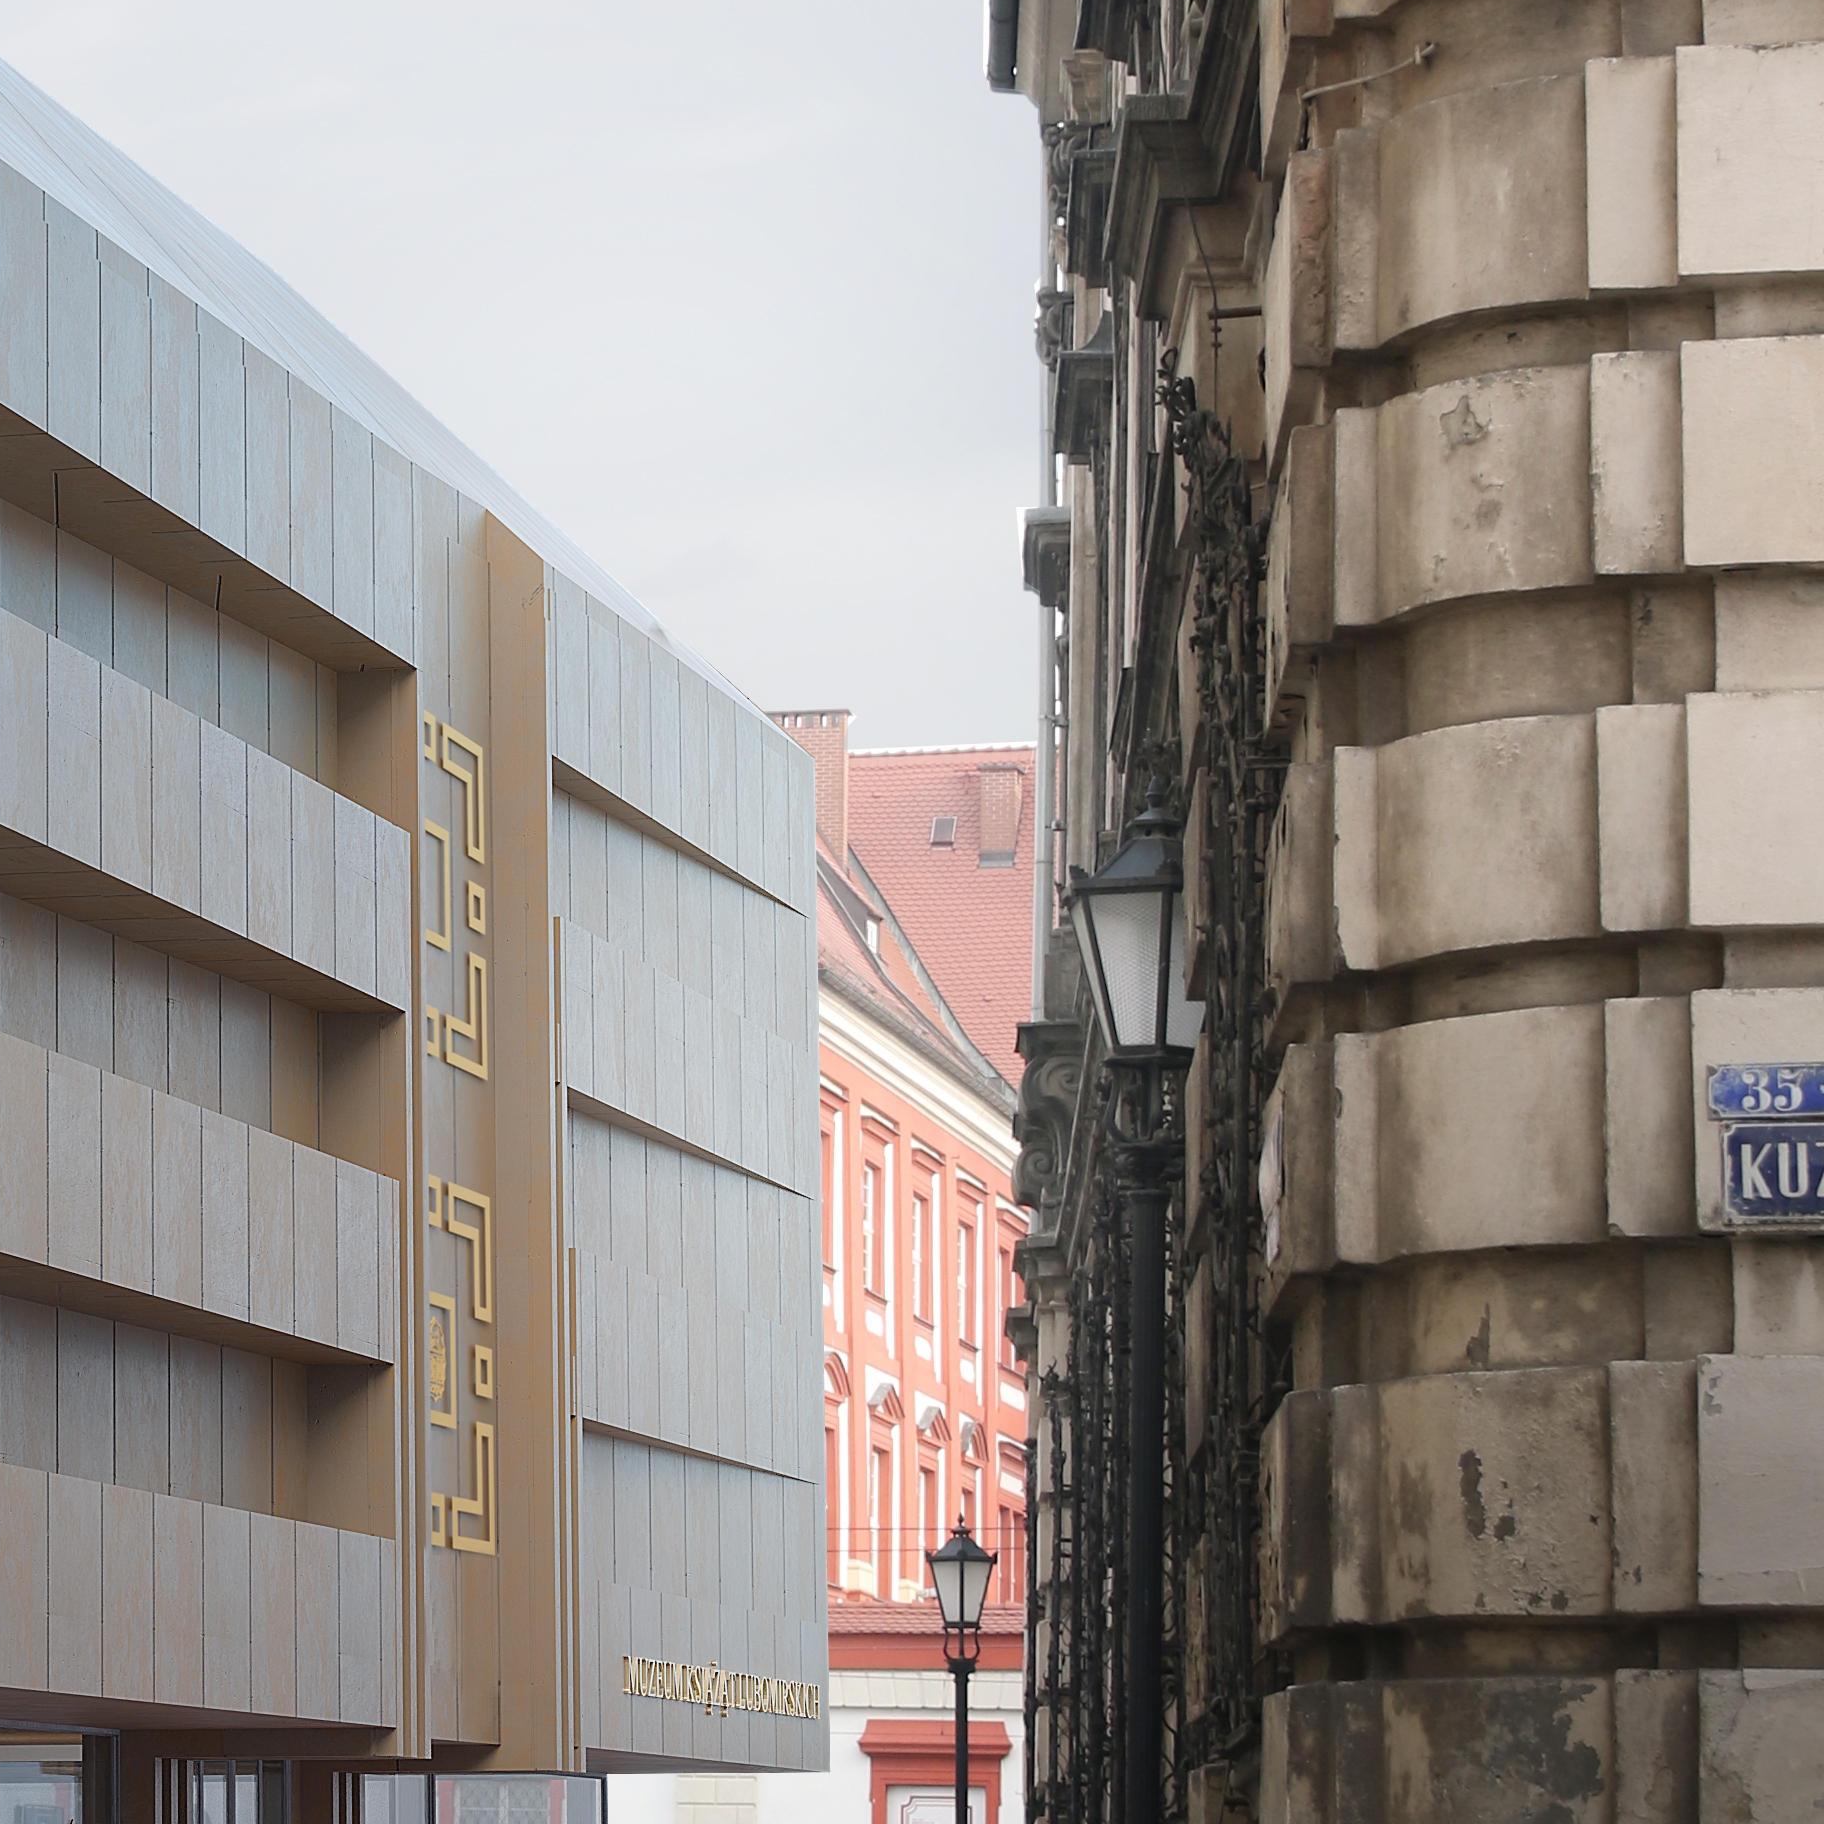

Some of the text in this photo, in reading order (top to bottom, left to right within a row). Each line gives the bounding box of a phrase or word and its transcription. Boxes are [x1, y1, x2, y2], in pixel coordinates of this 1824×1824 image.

[1741, 1067, 1805, 1113] 35
[623, 1655, 684, 1701] MUZEUM
[737, 1672, 820, 1719] LUBOMIRSKICH
